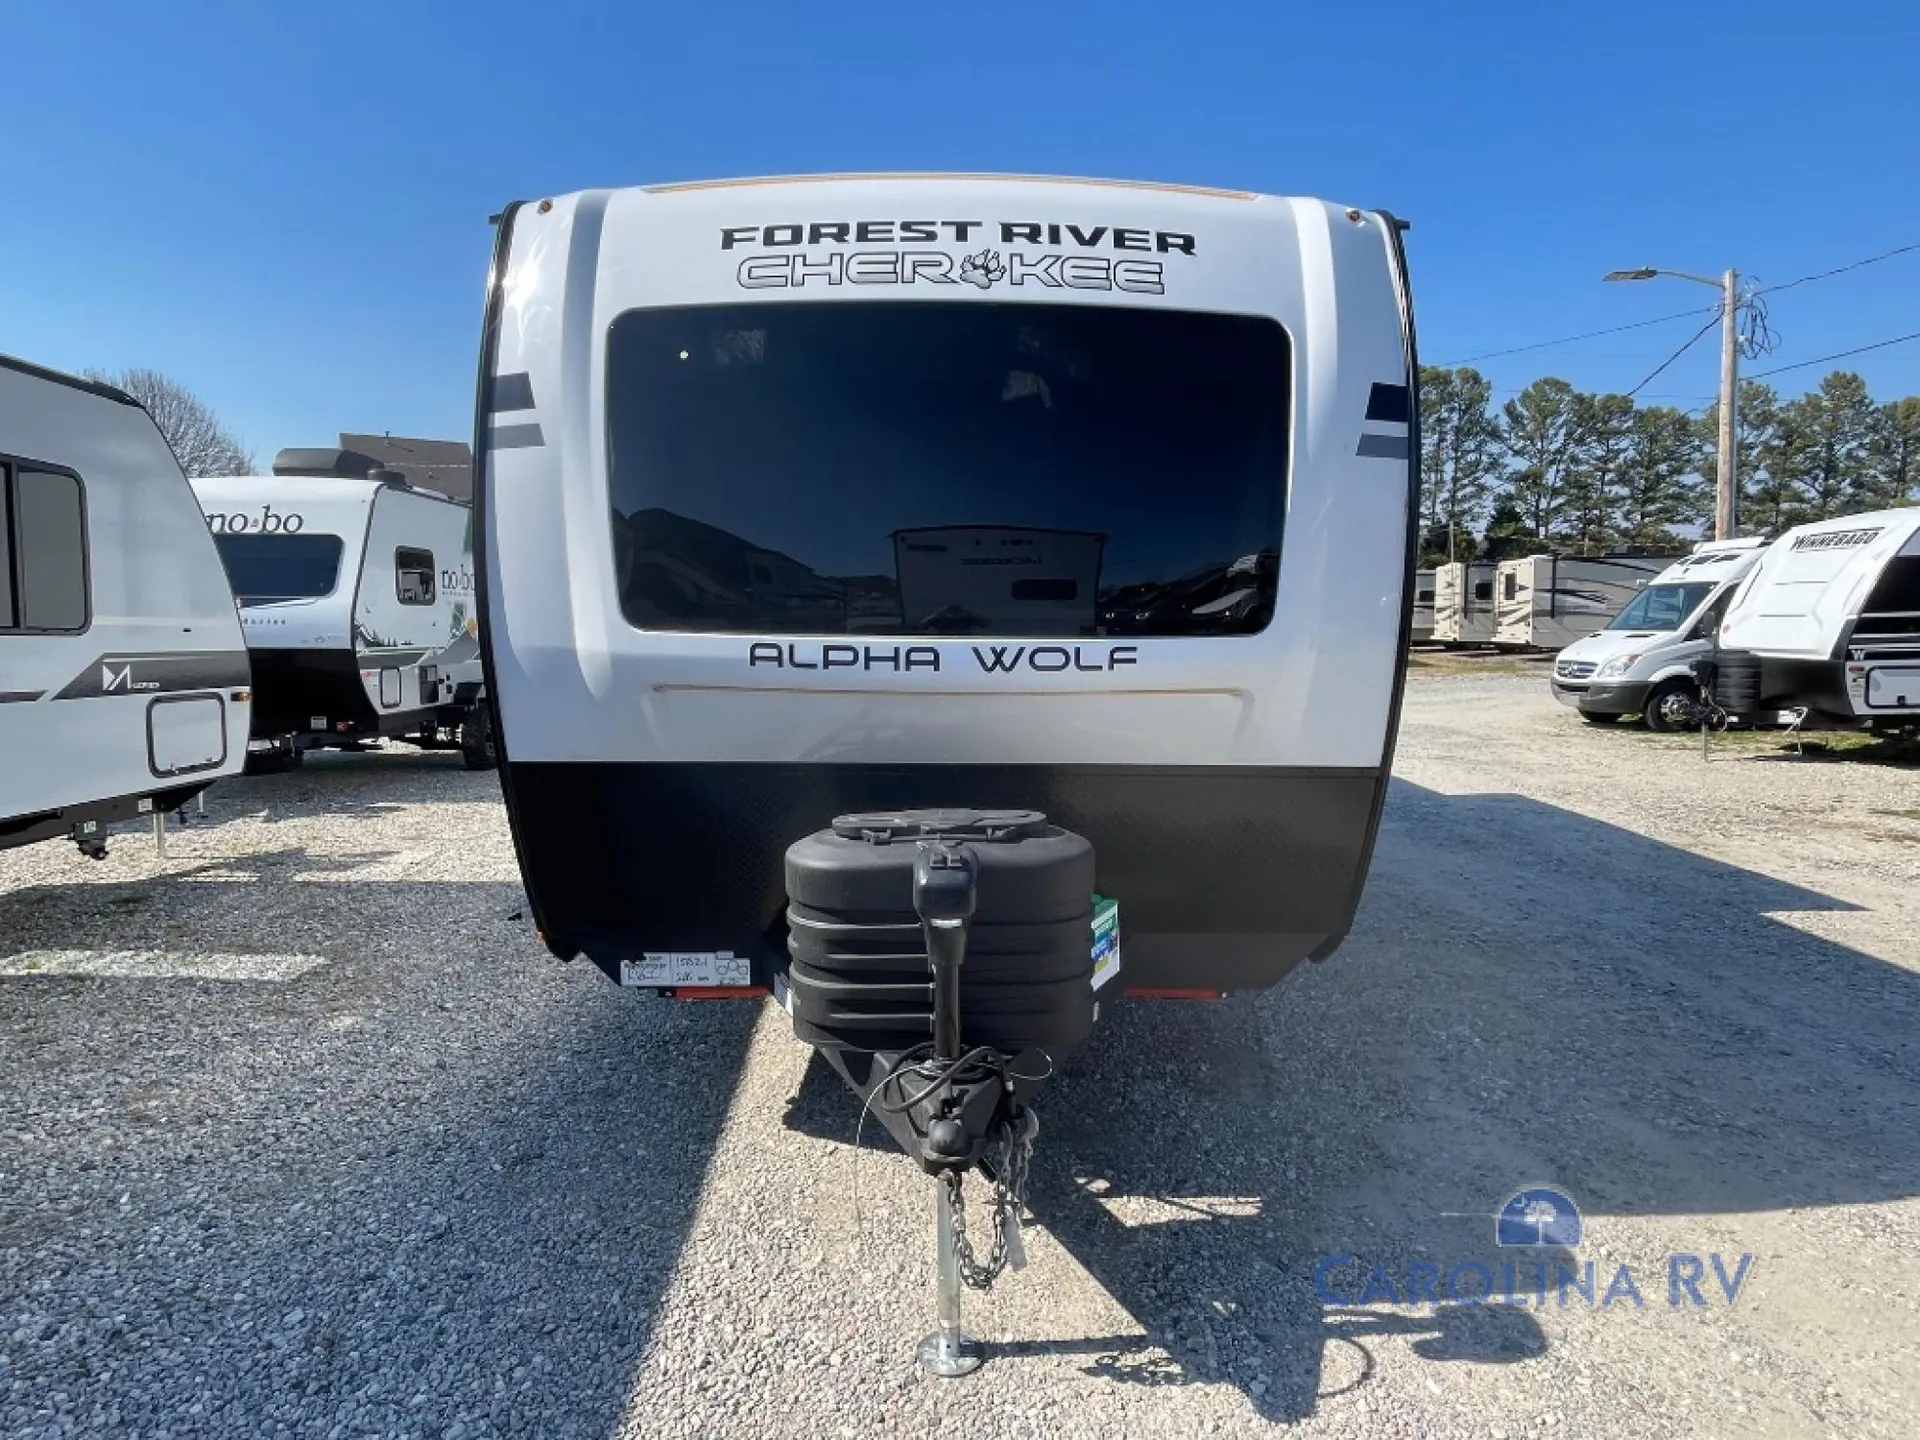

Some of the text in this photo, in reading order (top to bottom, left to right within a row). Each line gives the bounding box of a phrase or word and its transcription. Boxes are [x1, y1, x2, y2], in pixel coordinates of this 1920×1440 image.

[721, 220, 1197, 257] FOREST RIVER
[1789, 529, 1881, 552] WINNEBAGO
[748, 642, 1138, 673] ALPHA WOLF
